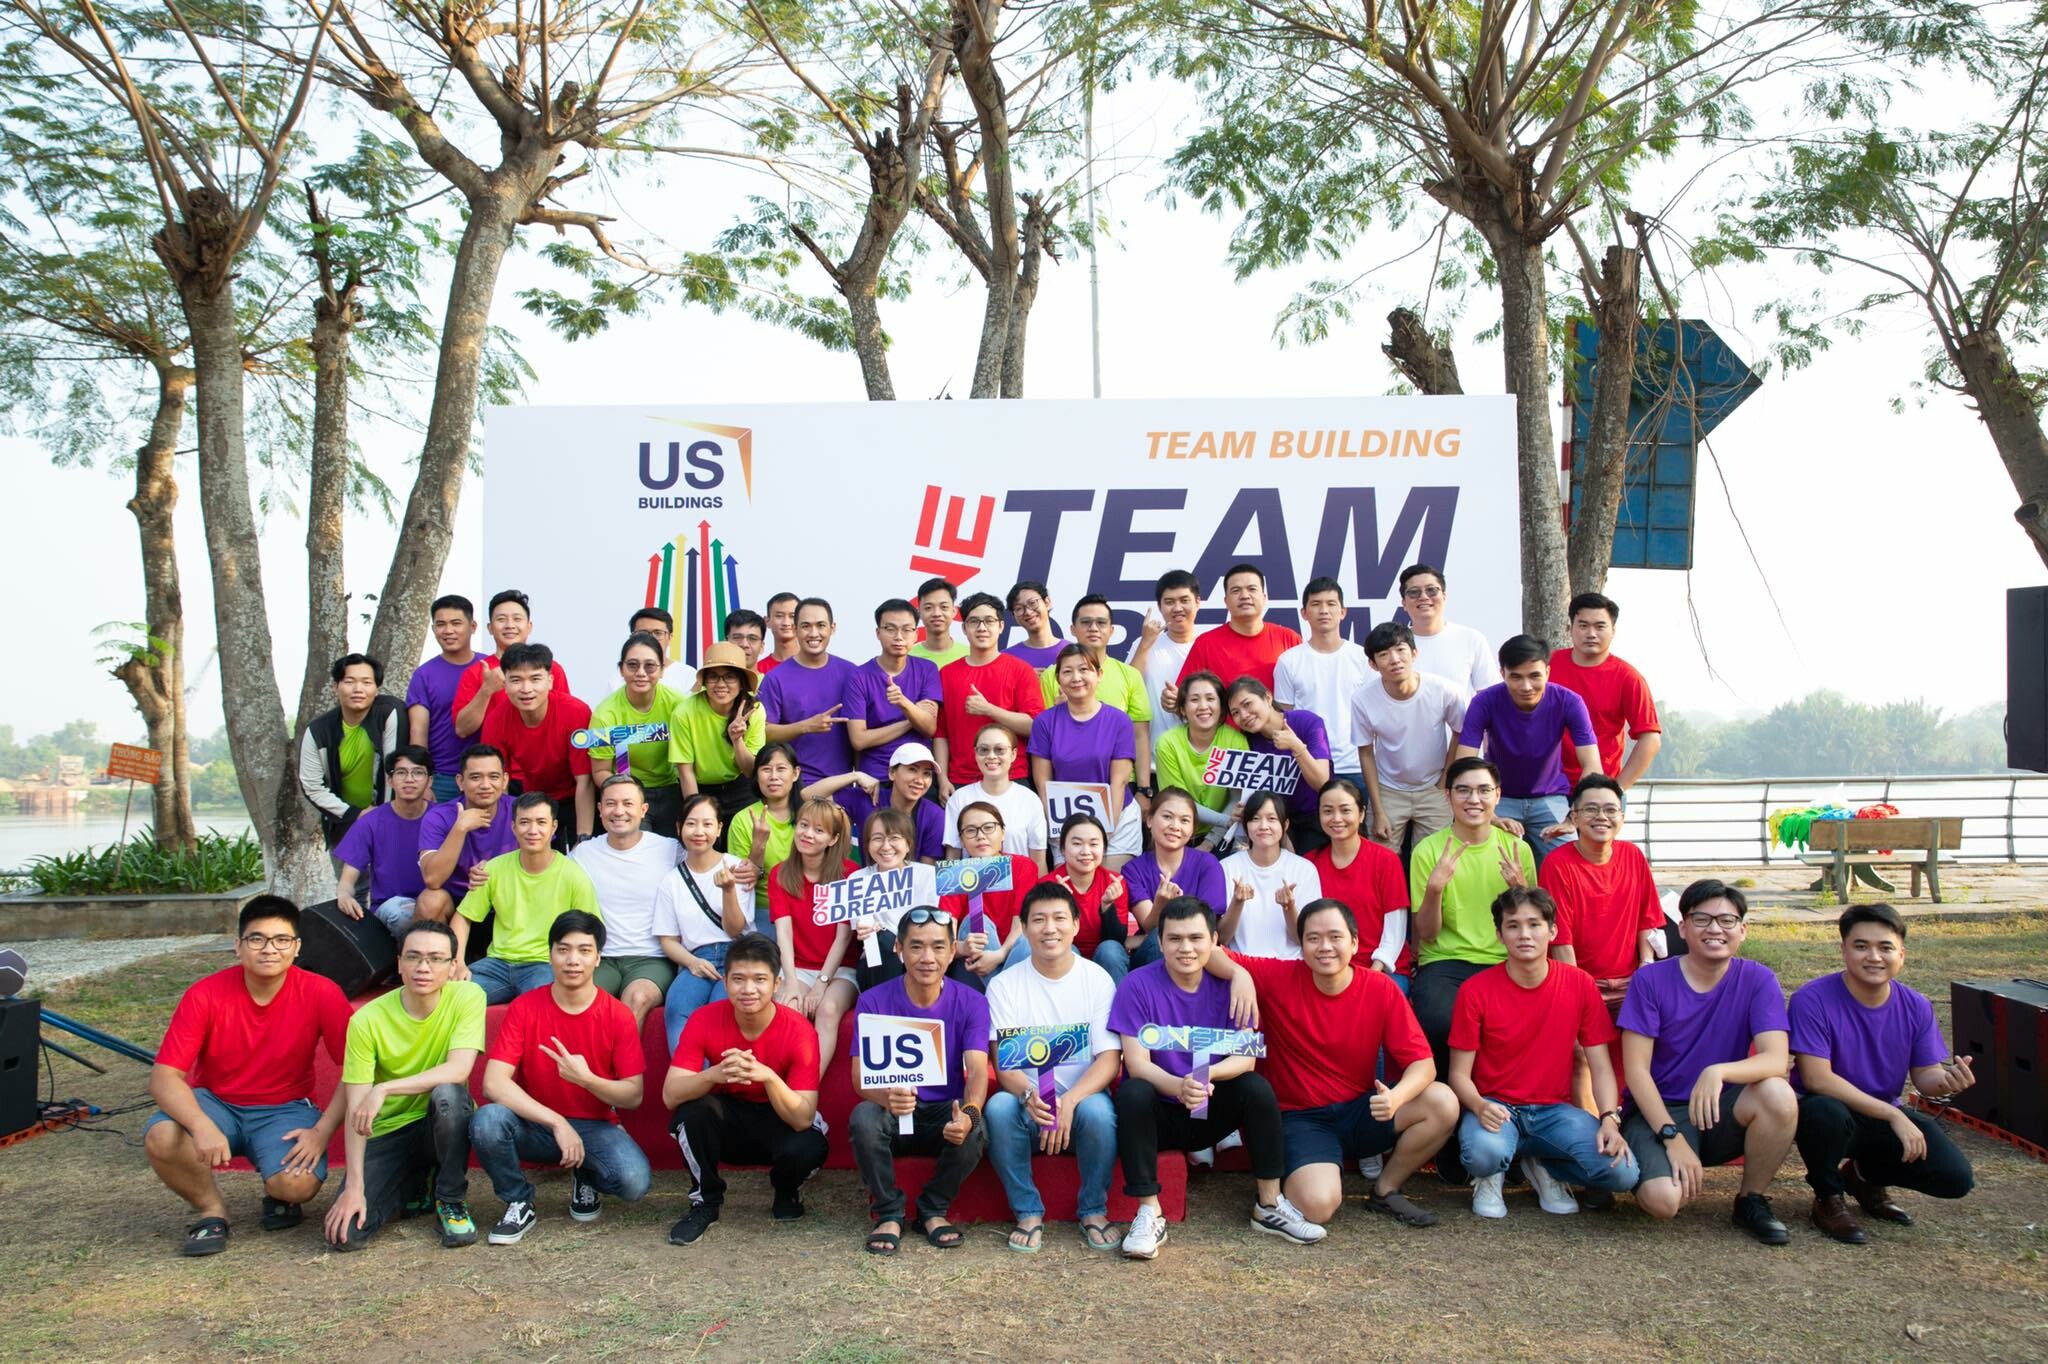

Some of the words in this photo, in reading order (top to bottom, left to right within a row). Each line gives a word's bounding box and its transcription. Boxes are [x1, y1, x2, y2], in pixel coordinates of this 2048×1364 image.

[1146, 431, 1256, 459] TEAM
[1269, 429, 1461, 458] BUILDING
[639, 441, 724, 490] US
[638, 496, 723, 509] BUILDINGS
[1003, 486, 1460, 602] TEAM
[628, 723, 665, 734] TEAM
[1203, 748, 1225, 784] ONE
[1226, 750, 1301, 778] TEAM
[1217, 770, 1296, 793] DREAM
[1049, 795, 1095, 823] US
[830, 867, 913, 904] TEAM
[814, 885, 829, 924] ONE
[830, 890, 912, 922] DREAM
[998, 1028, 1027, 1037] YEAR
[1030, 1025, 1052, 1035] END
[1213, 1029, 1260, 1044] TEAM
[862, 1034, 923, 1070] US
[998, 1033, 1090, 1067] 2021
[864, 1073, 924, 1085] BUILDINGS
